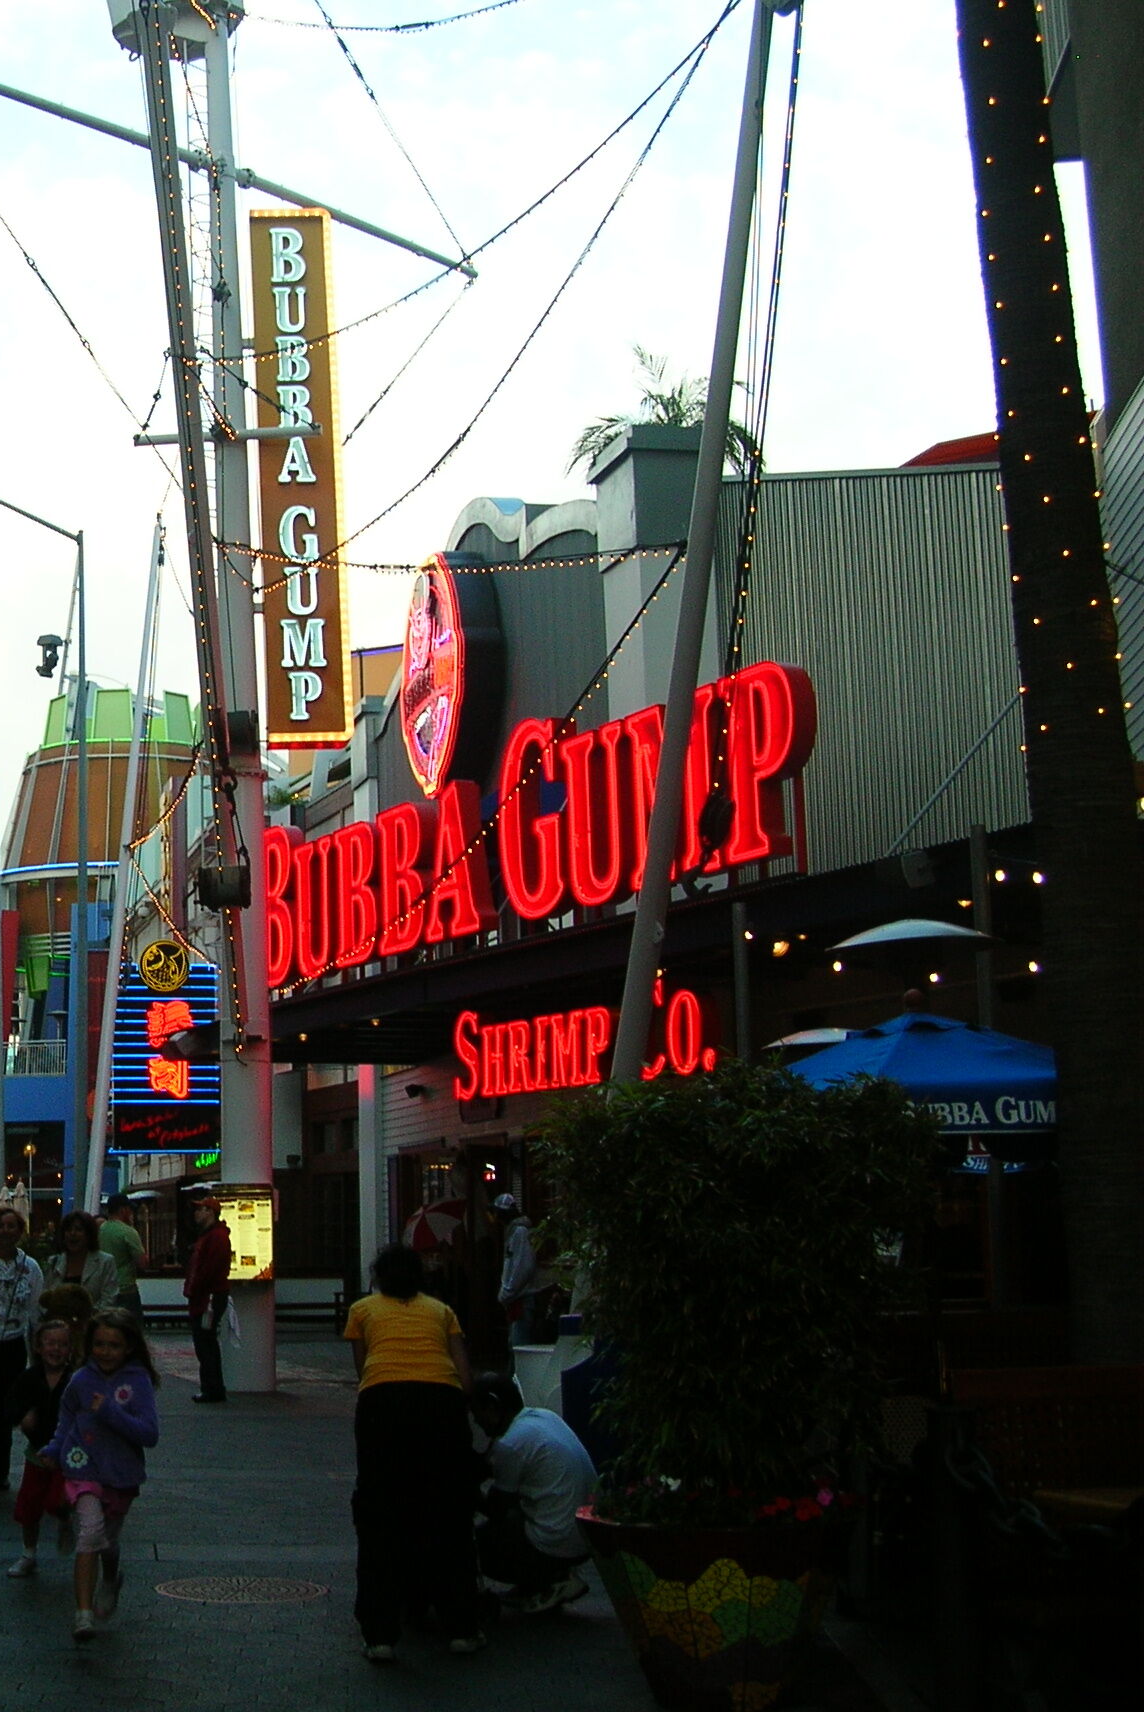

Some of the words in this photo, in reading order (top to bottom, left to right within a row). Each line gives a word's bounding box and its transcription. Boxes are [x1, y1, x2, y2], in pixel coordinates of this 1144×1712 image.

[269, 226, 316, 484] BUBBA
[278, 505, 327, 721] GUMP
[264, 780, 482, 987] BUBBA
[498, 660, 794, 920] GUMP
[455, 1006, 611, 1100] SHRIMP
[902, 1100, 990, 1126] BBA
